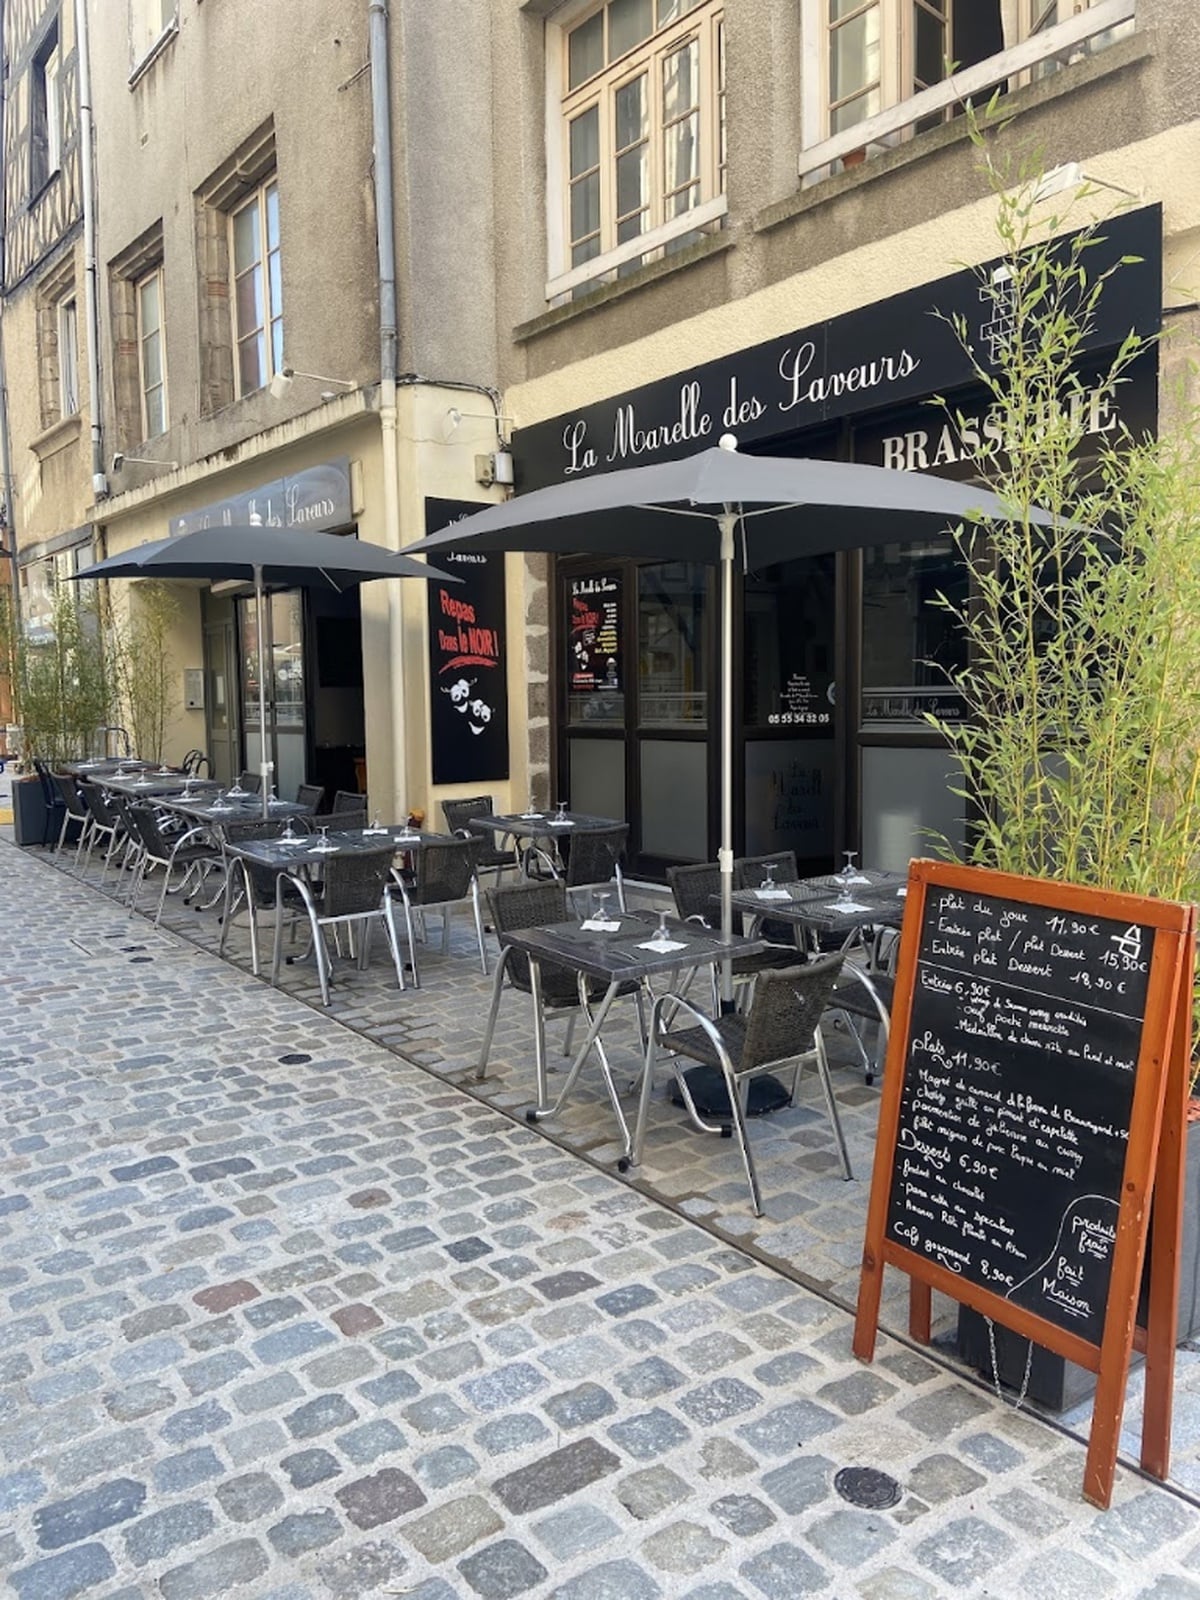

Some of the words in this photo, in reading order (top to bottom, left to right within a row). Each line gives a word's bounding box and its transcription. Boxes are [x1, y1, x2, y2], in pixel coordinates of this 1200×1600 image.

[563, 420, 598, 474] La
[607, 381, 712, 461] Marelle
[722, 376, 767, 427] des
[779, 341, 920, 411] Laveurs
[284, 484, 335, 527] Laveurs
[440, 589, 476, 625] Repas
[438, 629, 458, 652] Dans
[457, 625, 469, 653] le
[973, 900, 993, 916] du
[1000, 911, 1028, 928] jour
[973, 948, 998, 966] plat
[1008, 957, 1053, 977] Dessert
[977, 930, 1003, 947] plat
[1023, 936, 1045, 953] plat
[1050, 944, 1087, 961] Dessert
[1099, 949, 1148, 973] 15,90€
[954, 981, 992, 998] 6,90€
[995, 1012, 1022, 1029] poché
[967, 1114, 981, 1128] de
[971, 1133, 984, 1147] de
[959, 1153, 999, 1180] 6,90€
[980, 1259, 1014, 1287] 8,90€
[1042, 1277, 1094, 1314] Maison
